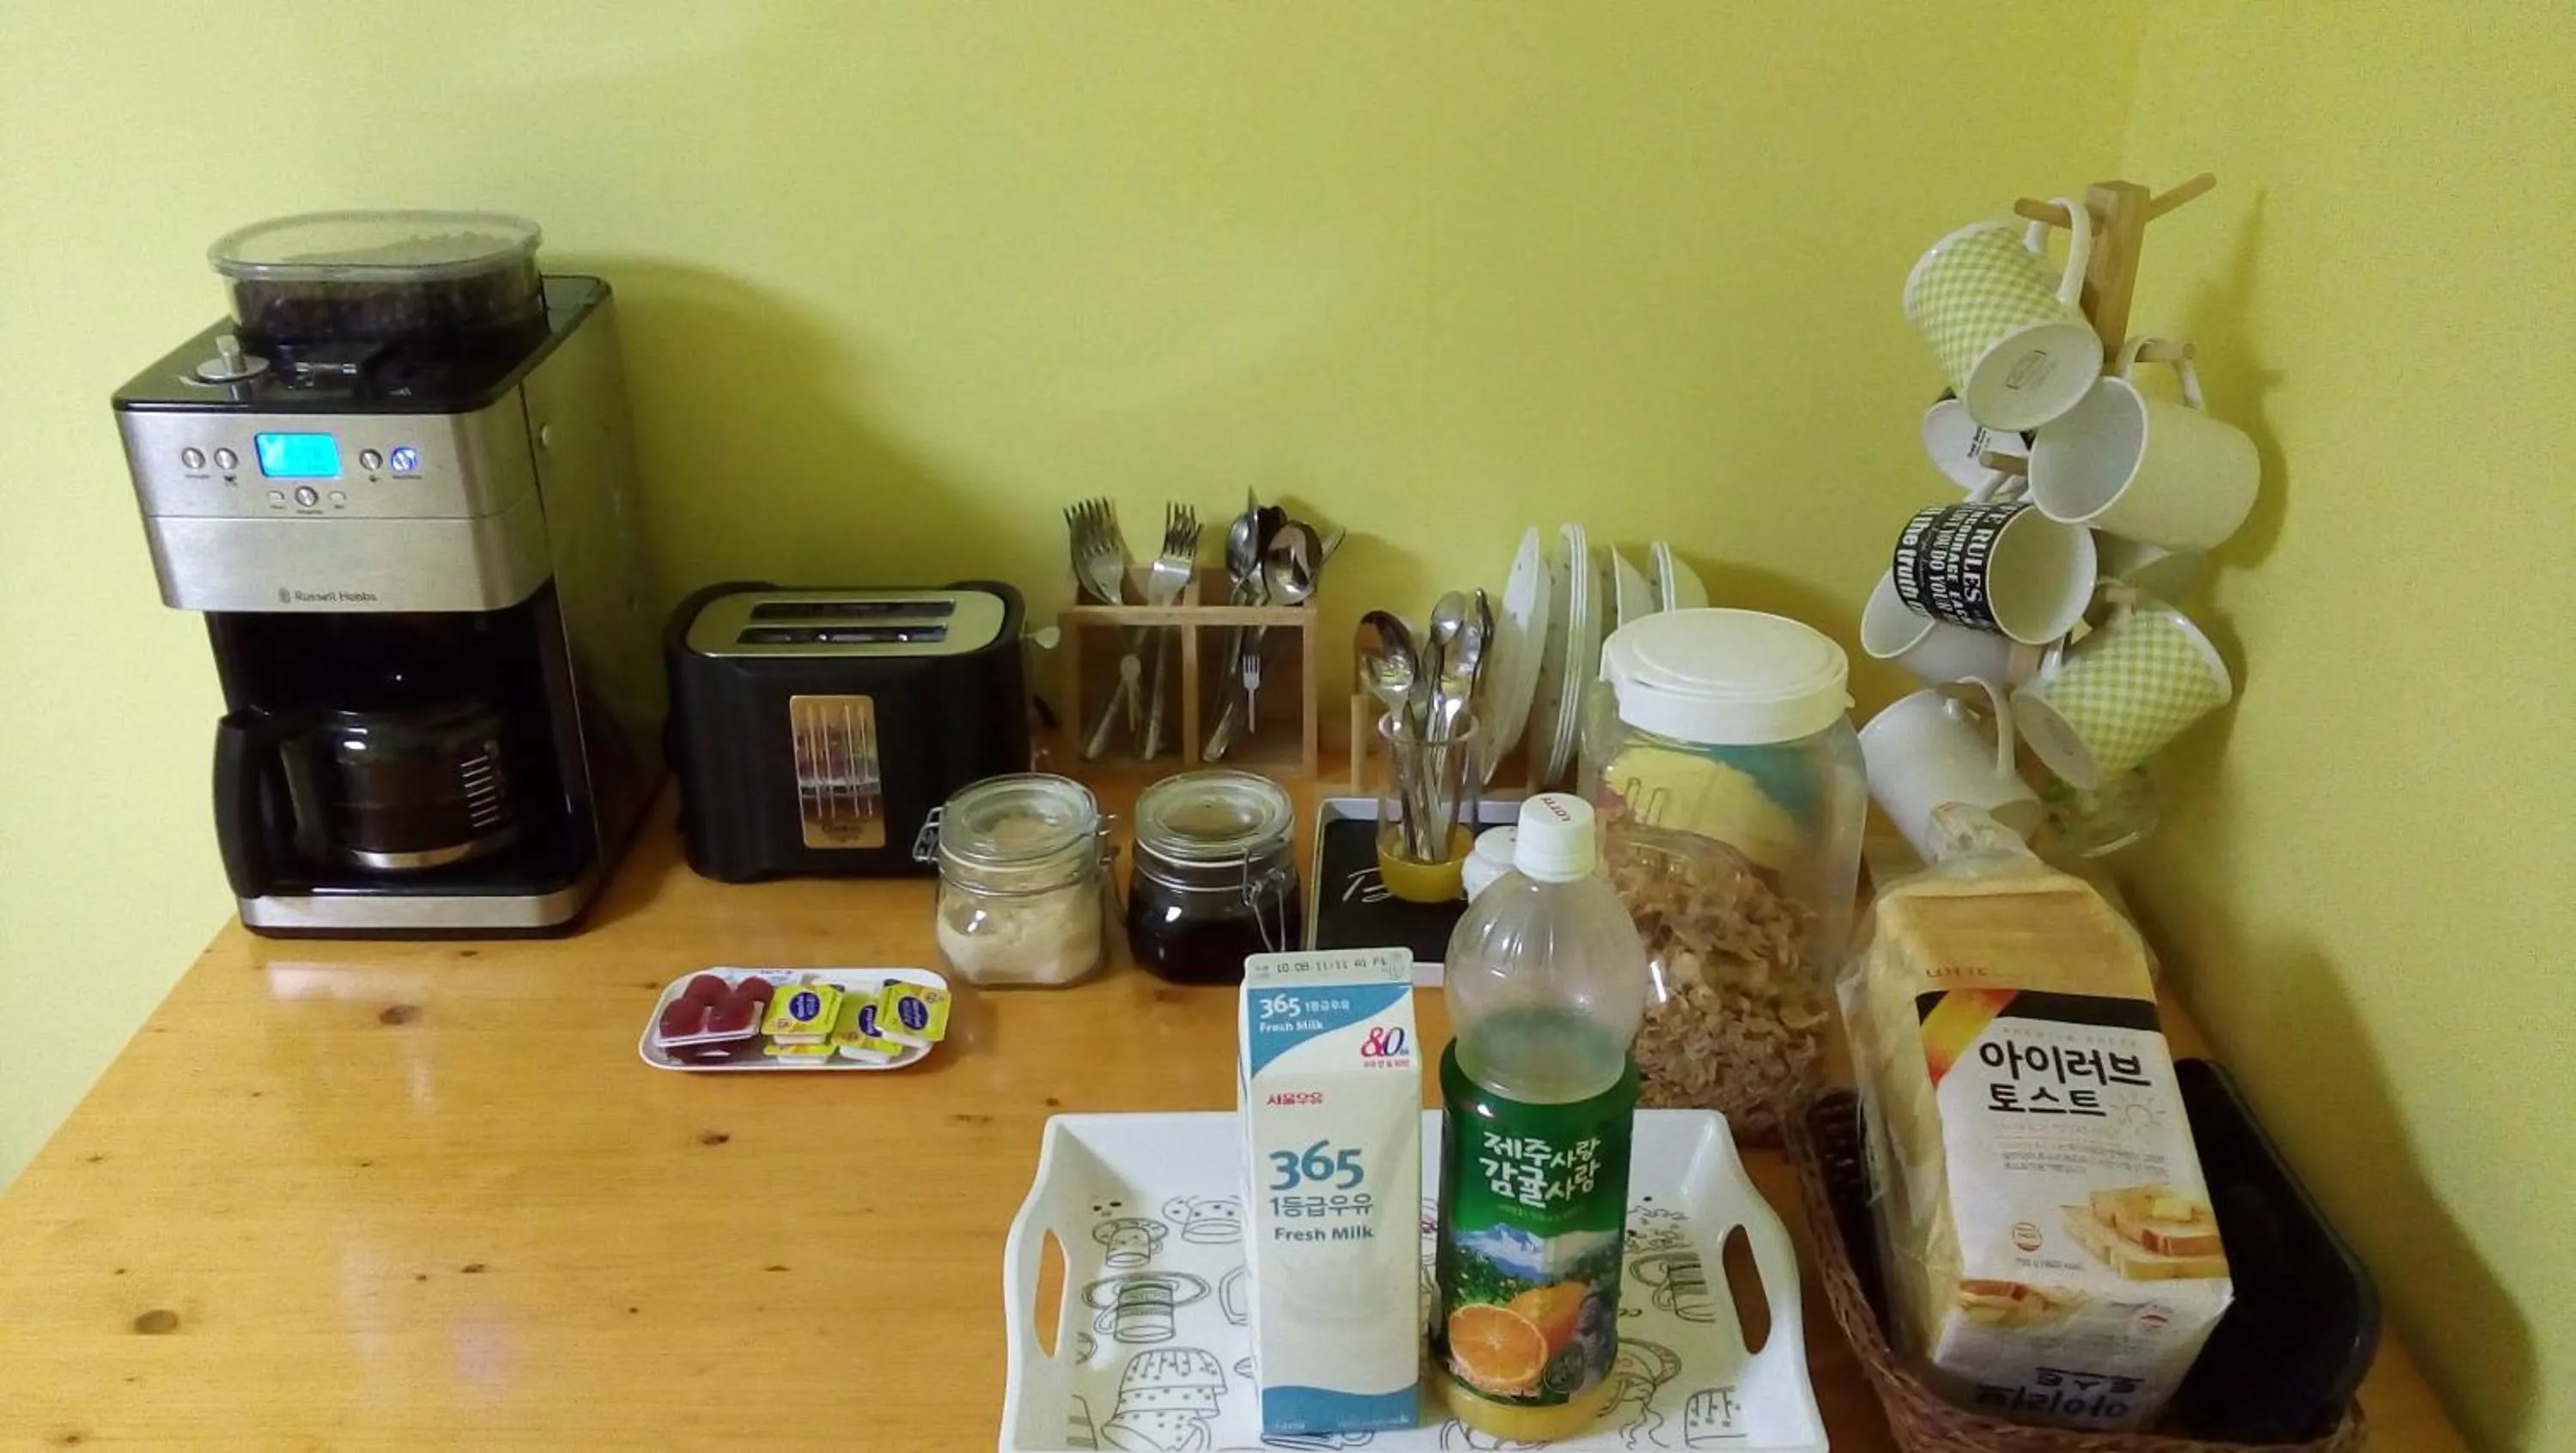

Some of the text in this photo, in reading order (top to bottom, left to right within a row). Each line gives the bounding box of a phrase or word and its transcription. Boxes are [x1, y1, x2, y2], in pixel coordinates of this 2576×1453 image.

[1903, 516, 1934, 545] the
[1896, 549, 1919, 599] truth
[1929, 550, 1948, 571] DO
[1963, 527, 1995, 602] RULES
[295, 589, 378, 602] Russell Hobbs
[1540, 797, 1571, 821] LOTTE
[1259, 993, 1302, 1019] 365
[1259, 1018, 1323, 1034] Fresh Milk
[1360, 1026, 1405, 1057] 80
[1979, 1040, 2152, 1086] 아이러브
[1988, 1083, 2107, 1117] 토스트
[1267, 1139, 1365, 1191] 365
[1483, 1131, 1602, 1169] 제주사랑
[1478, 1157, 1602, 1209] 감귤사랑
[1268, 1193, 1374, 1218] 1등급우유
[1274, 1225, 1375, 1241] Fresh Milk
